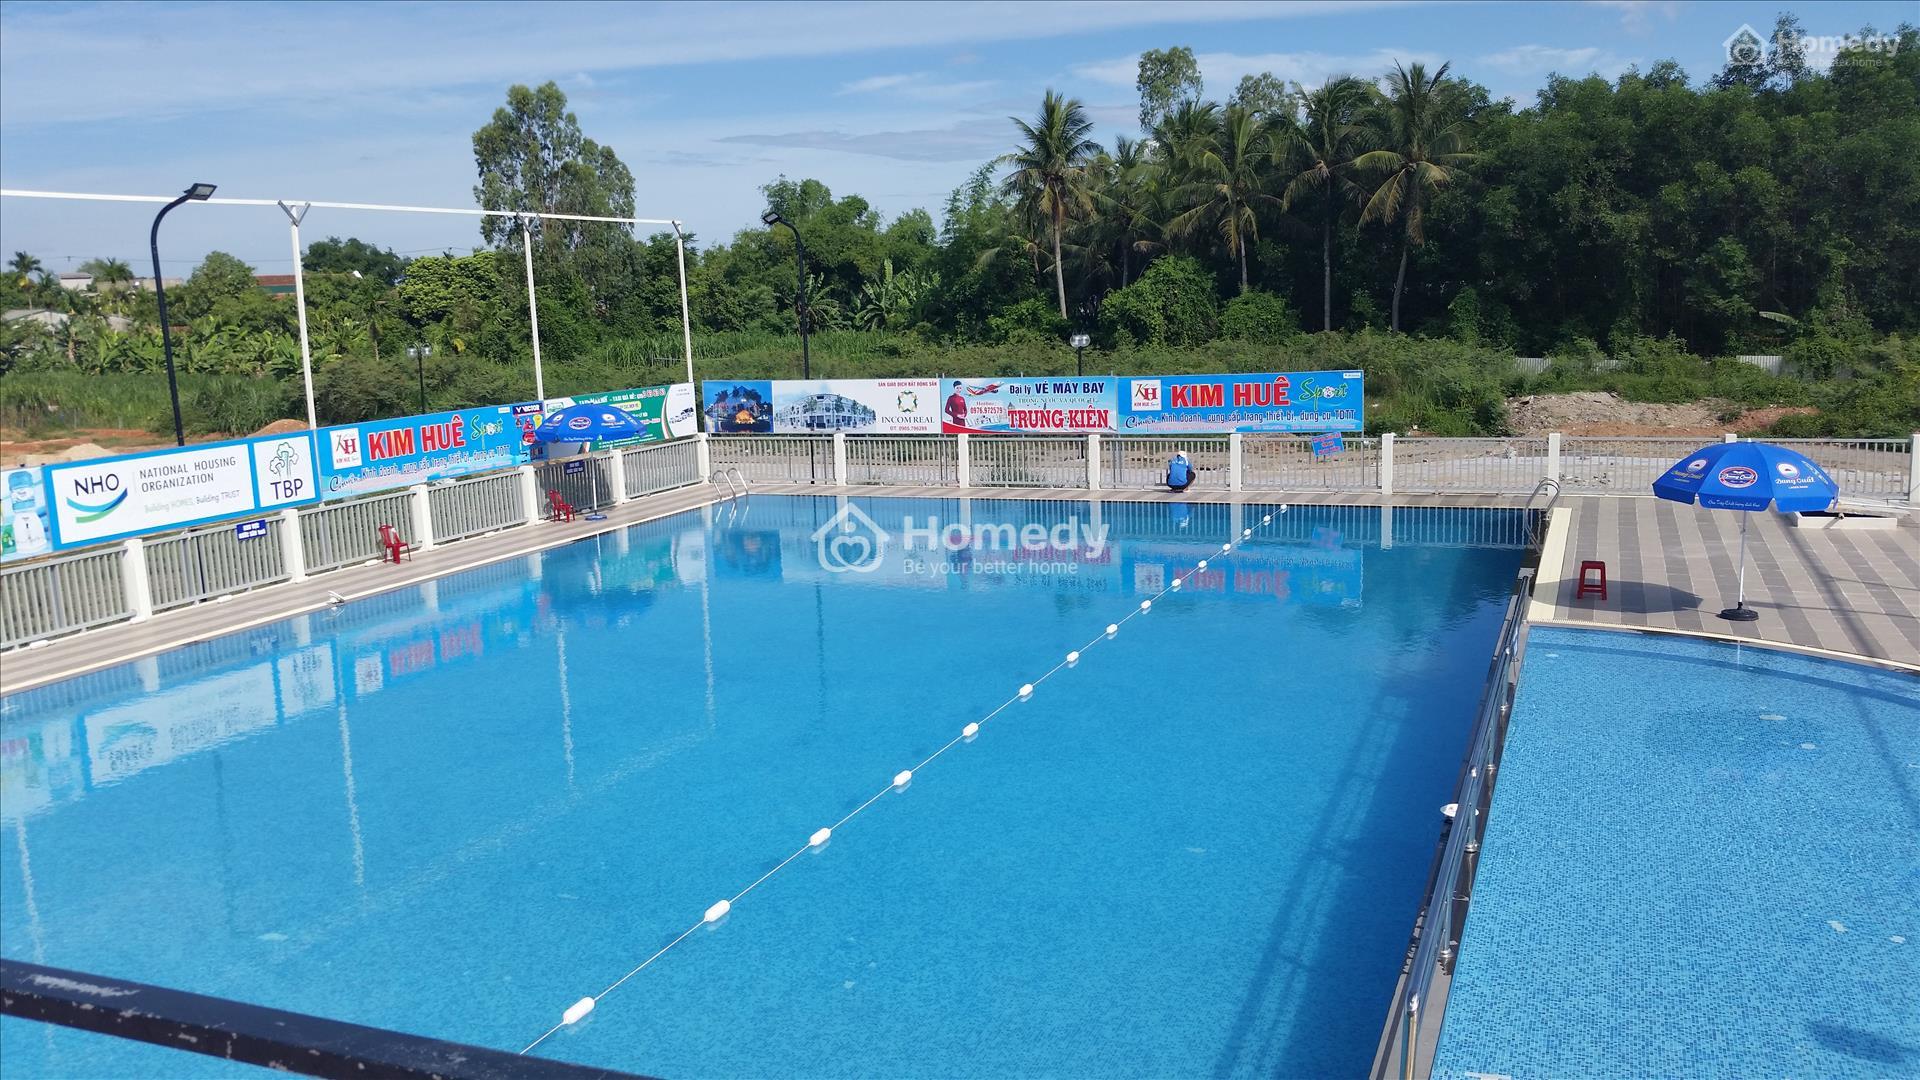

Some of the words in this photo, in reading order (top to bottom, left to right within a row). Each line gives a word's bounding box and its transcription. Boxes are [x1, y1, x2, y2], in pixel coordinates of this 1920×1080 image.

[1053, 380, 1078, 394] MÁY
[1083, 382, 1104, 394] BAY
[1171, 384, 1224, 408] KIM
[1233, 375, 1290, 407] HUÊ
[1299, 377, 1348, 411] Sport
[1008, 409, 1065, 429] TRUNG
[1069, 405, 1109, 428] KIÊN
[1244, 411, 1263, 423] trang
[368, 428, 415, 461] KIM
[421, 414, 466, 452] HUÊ
[139, 463, 188, 479] NATIONAL
[194, 456, 236, 471] HOUSING
[74, 473, 120, 497] NHO
[141, 472, 215, 493] ORGANIZATION
[270, 478, 303, 500] TBP
[195, 494, 220, 505] Building
[221, 490, 241, 499] TRUST
